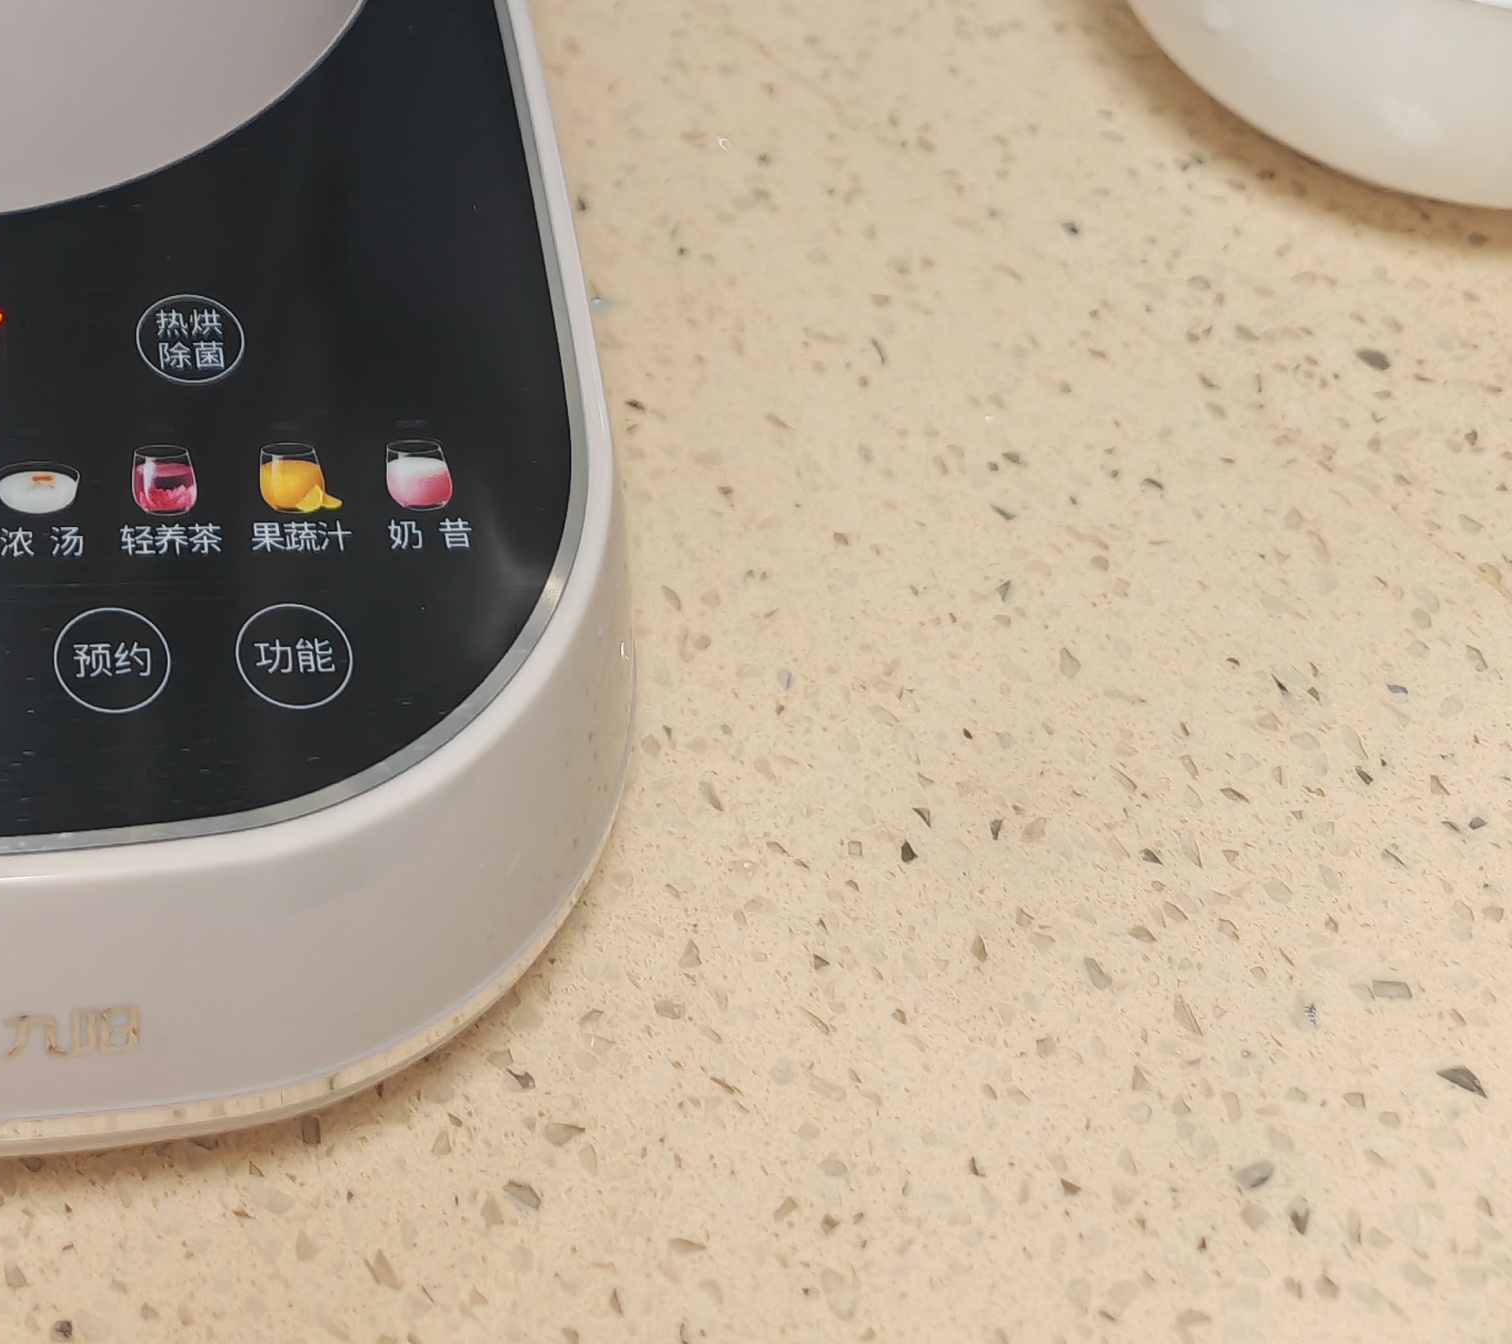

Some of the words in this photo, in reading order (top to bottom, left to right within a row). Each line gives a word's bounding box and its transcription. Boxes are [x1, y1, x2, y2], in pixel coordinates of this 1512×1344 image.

[155, 308, 223, 337] 热烘
[158, 340, 226, 370] 除菌
[119, 522, 223, 556] 轻养茶
[251, 520, 352, 553] 果蔬汁
[73, 642, 152, 678] 预约
[253, 637, 336, 675] 功能
[4, 1004, 141, 1060] 九阳
